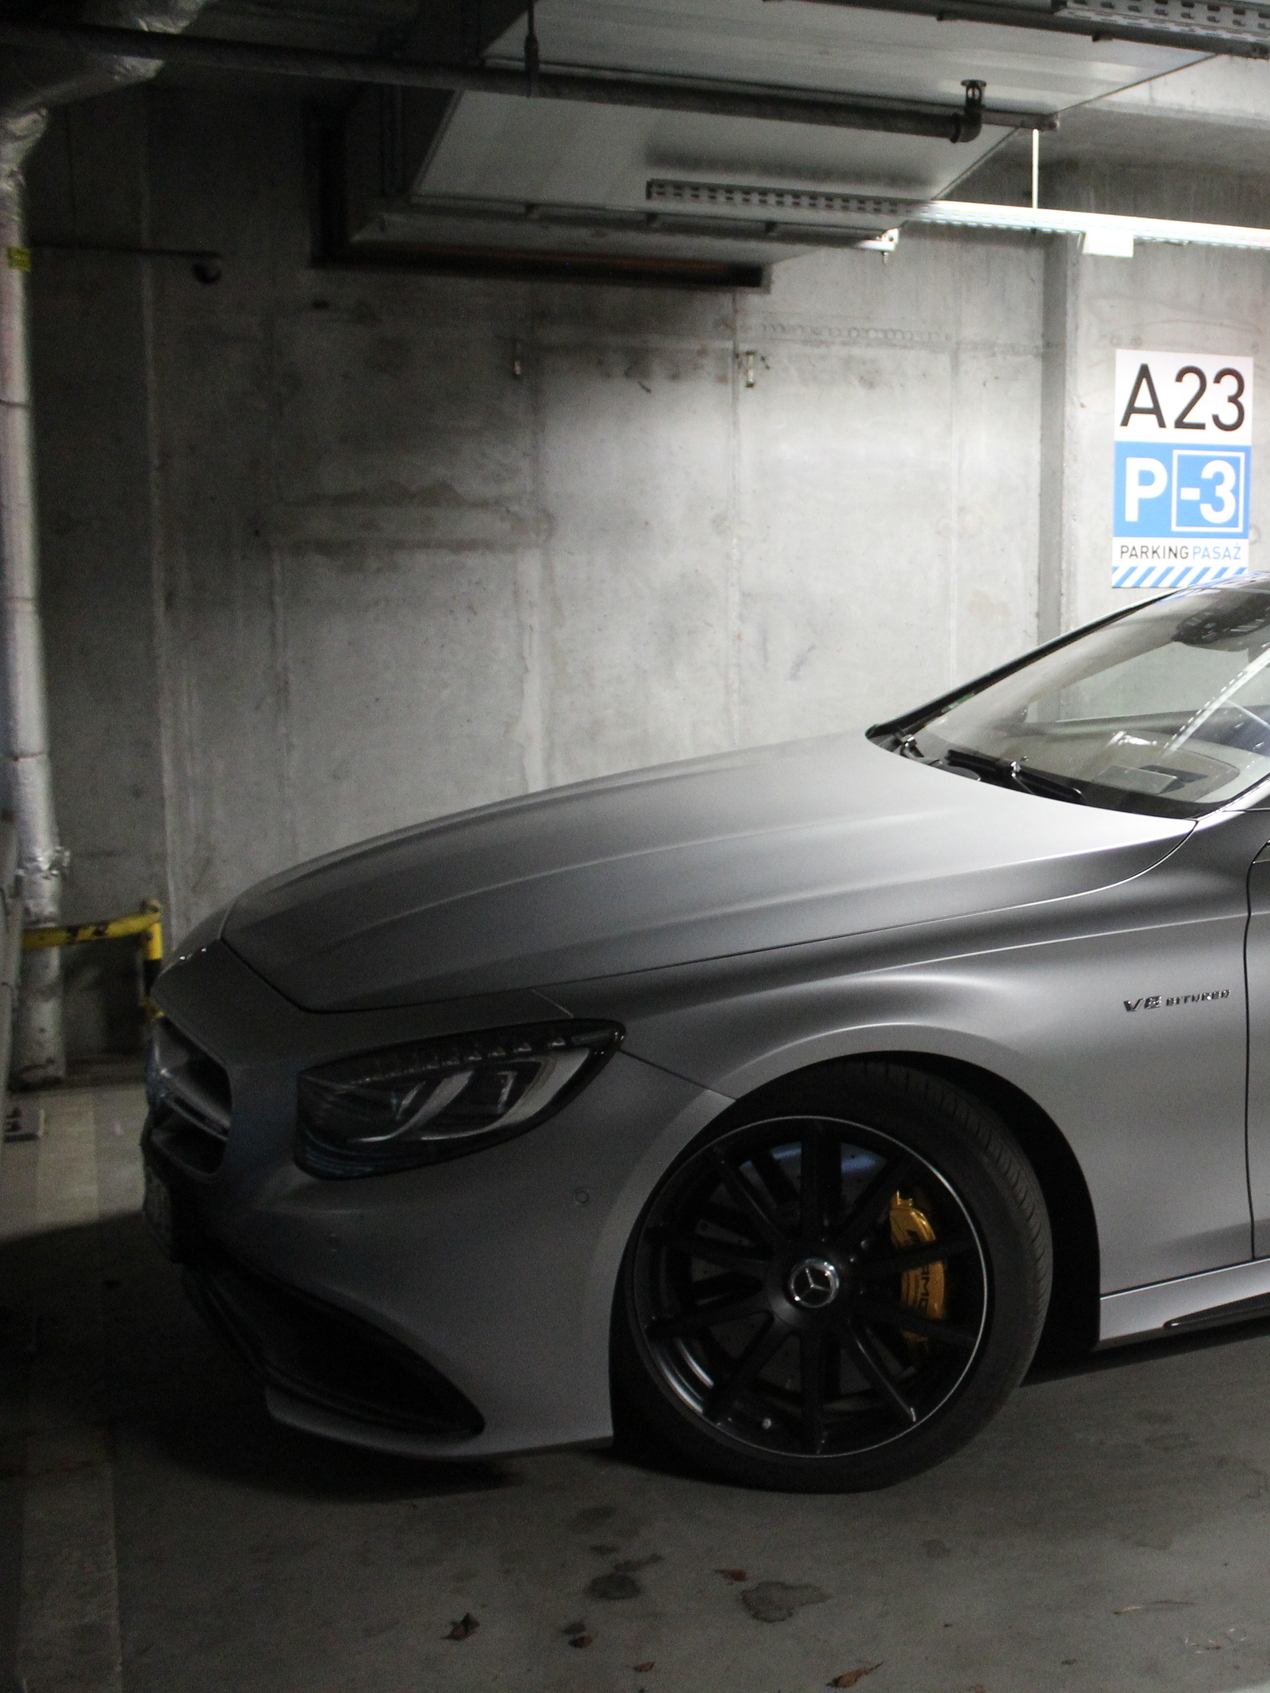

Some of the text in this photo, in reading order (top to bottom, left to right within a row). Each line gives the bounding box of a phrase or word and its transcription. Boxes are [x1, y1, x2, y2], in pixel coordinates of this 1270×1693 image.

[1119, 362, 1245, 432] A23
[1119, 542, 1242, 560] PARKING PASAŻ
